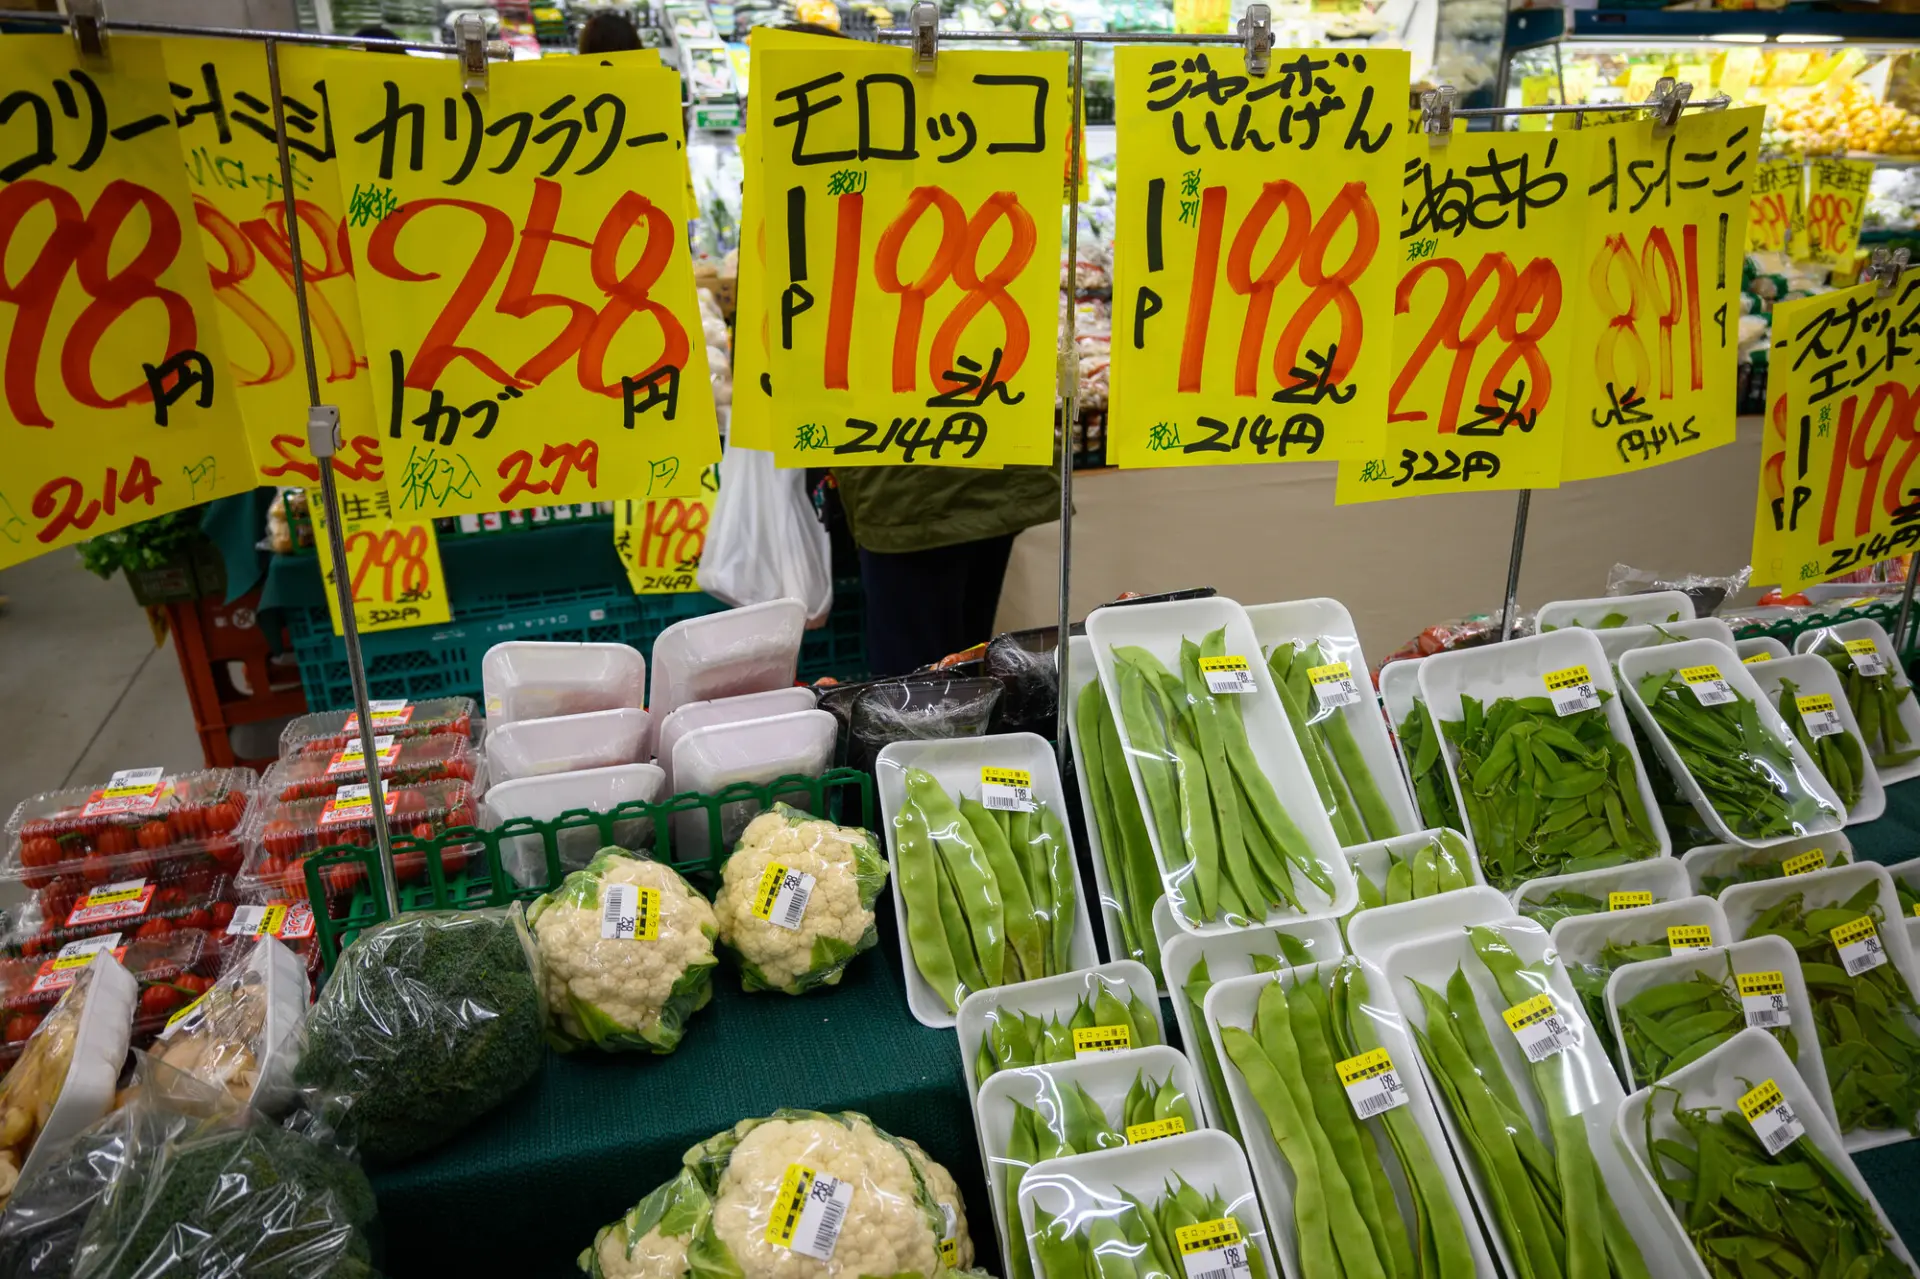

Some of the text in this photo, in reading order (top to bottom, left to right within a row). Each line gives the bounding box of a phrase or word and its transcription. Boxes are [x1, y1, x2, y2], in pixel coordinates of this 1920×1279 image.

[355, 80, 668, 186] カリフラワー
[774, 71, 1049, 165] モロッコ
[1172, 84, 1392, 155] いんげん
[367, 177, 690, 399] 258
[824, 185, 1037, 396] 198
[1177, 178, 1380, 398] 198
[1387, 252, 1563, 434] 298
[623, 364, 680, 429] 円
[834, 412, 988, 463] 214円
[1183, 413, 1325, 457] 214円
[1391, 449, 1500, 488] 322円
[32, 455, 162, 543] 214
[498, 439, 599, 503] 279
[344, 526, 429, 603] 298
[638, 498, 709, 568] 198
[783, 874, 799, 891] 258
[620, 916, 634, 932] 258
[1380, 1073, 1396, 1090] 198
[770, 1168, 797, 1237] カリフラワー
[811, 1180, 831, 1203] 258
[1223, 1247, 1240, 1265] 198
